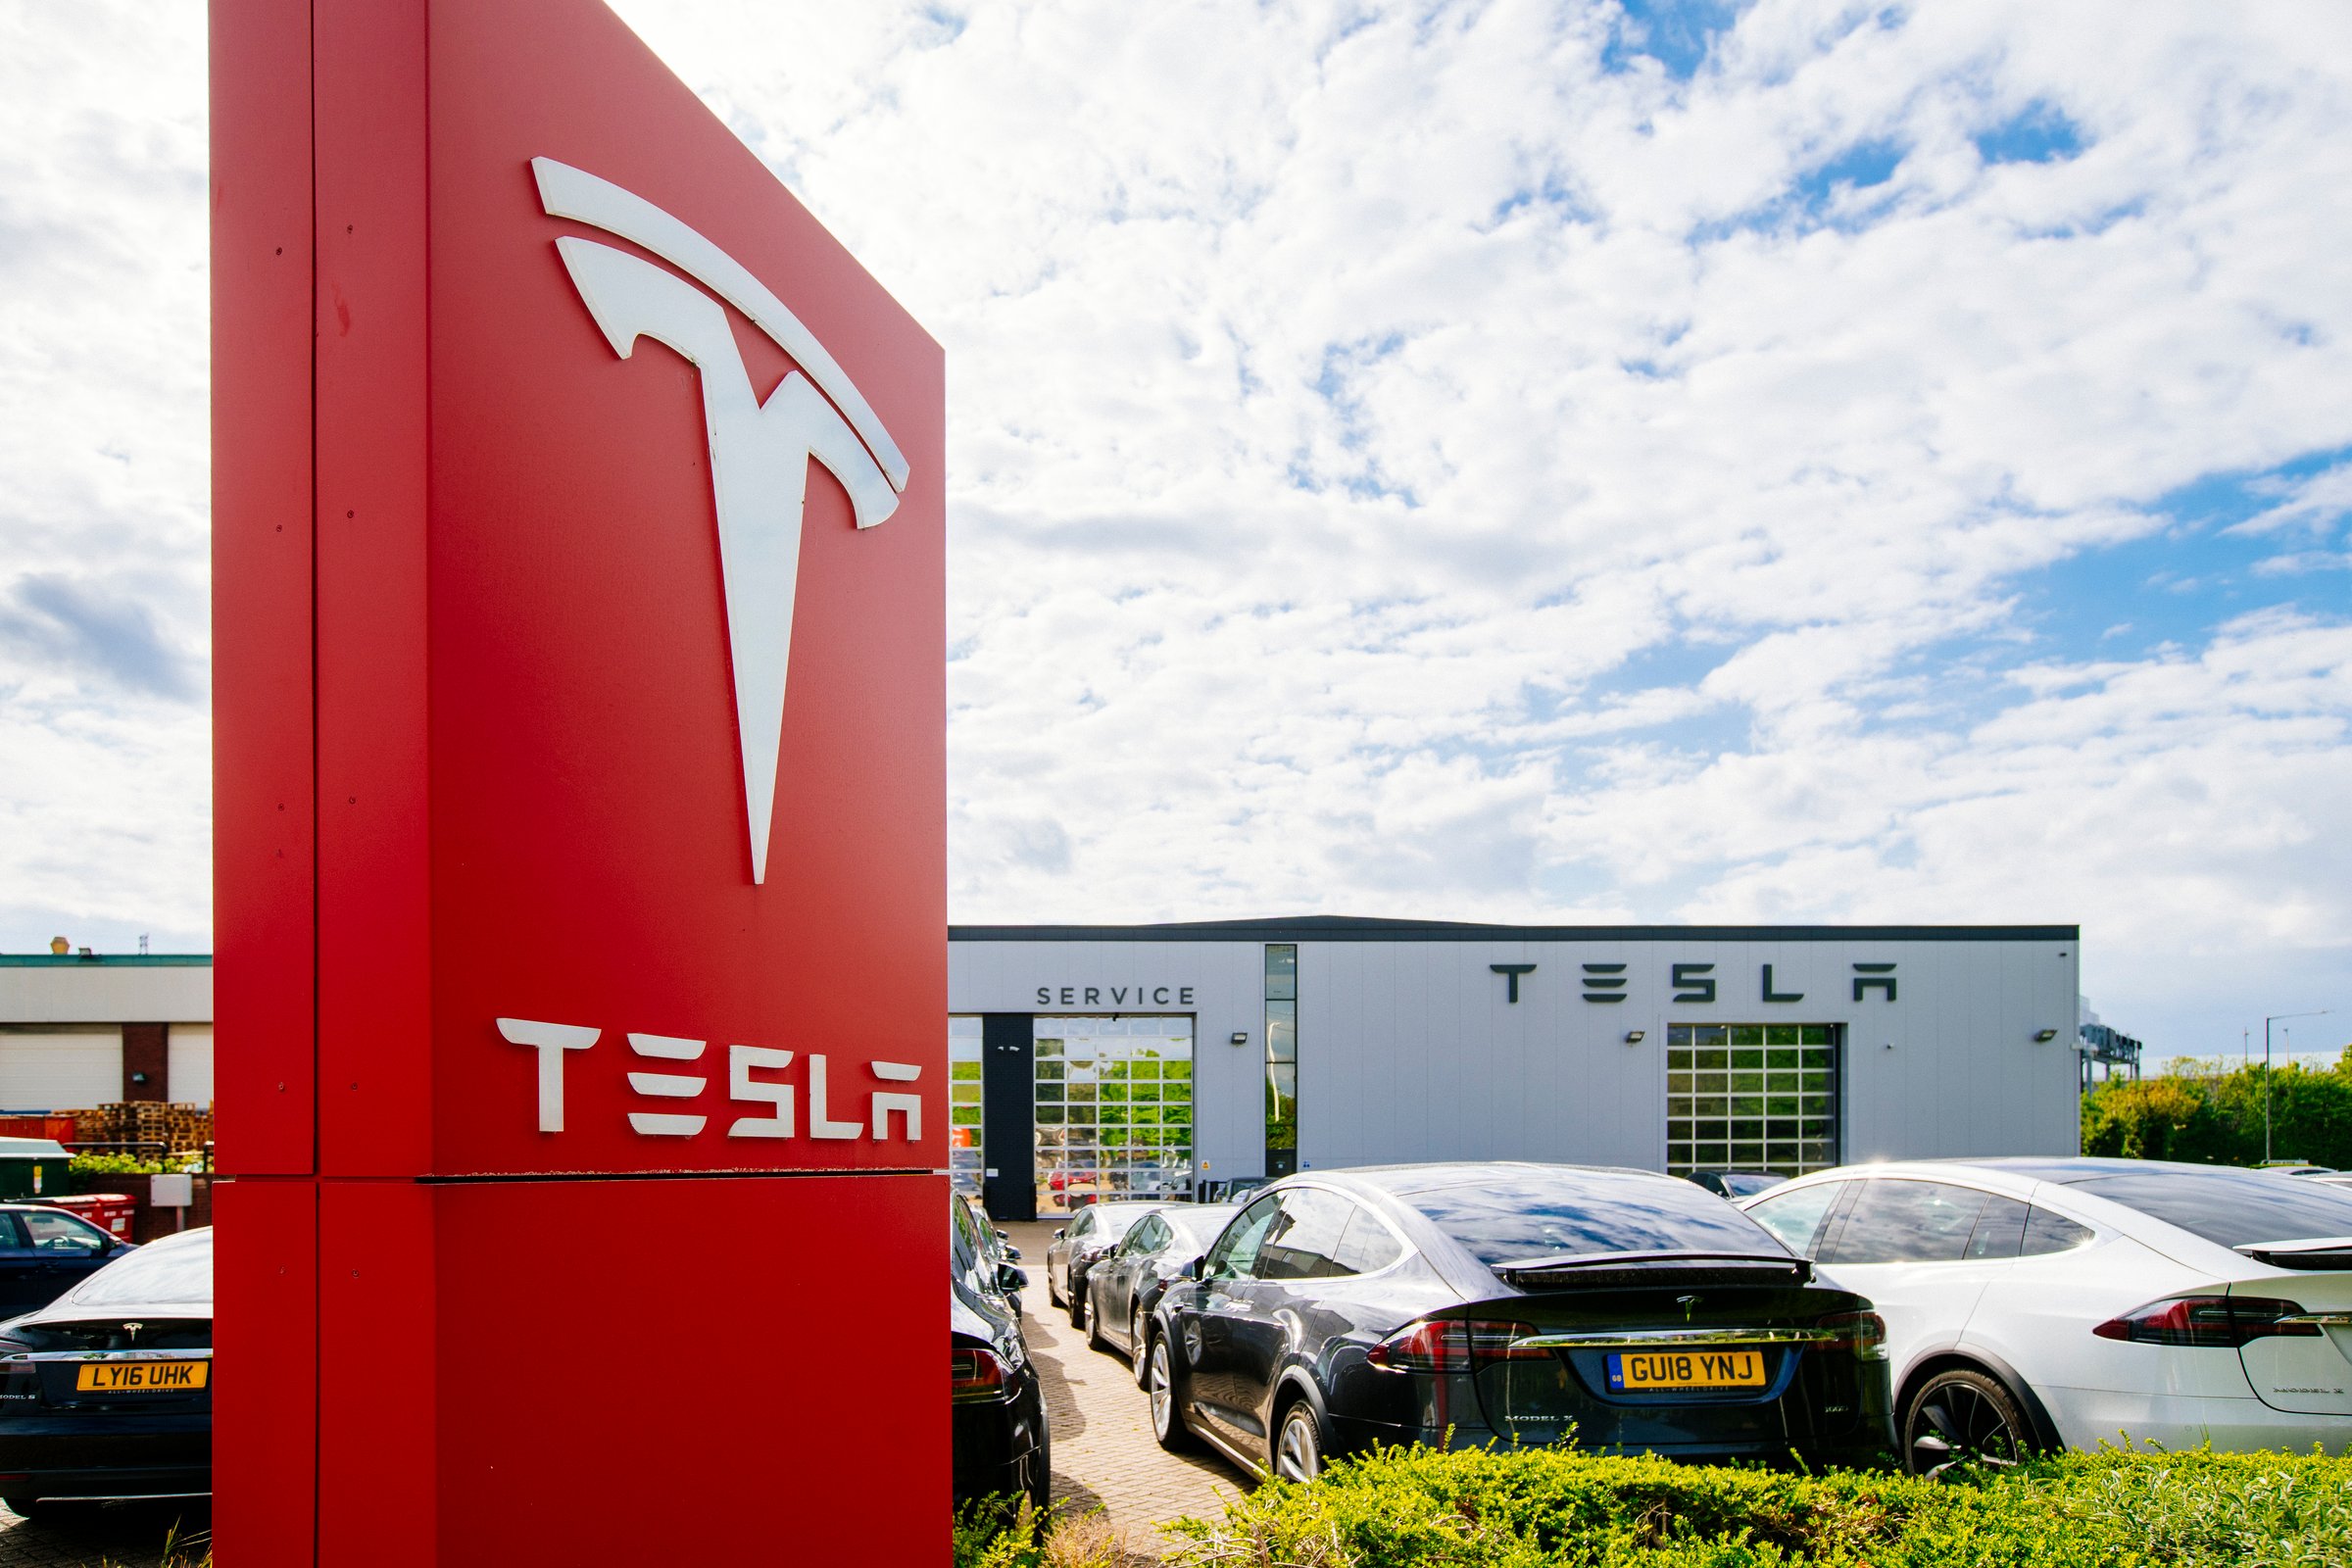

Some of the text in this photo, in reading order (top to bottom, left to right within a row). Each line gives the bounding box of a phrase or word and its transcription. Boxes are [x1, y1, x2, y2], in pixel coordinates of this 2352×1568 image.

[1037, 987, 1195, 1004] SERVICE
[1489, 963, 1897, 1004] TESLA
[496, 1017, 922, 1141] TESLA
[92, 1365, 194, 1387] LY16 UHK
[1631, 1355, 1753, 1381] GU18 YNJ
